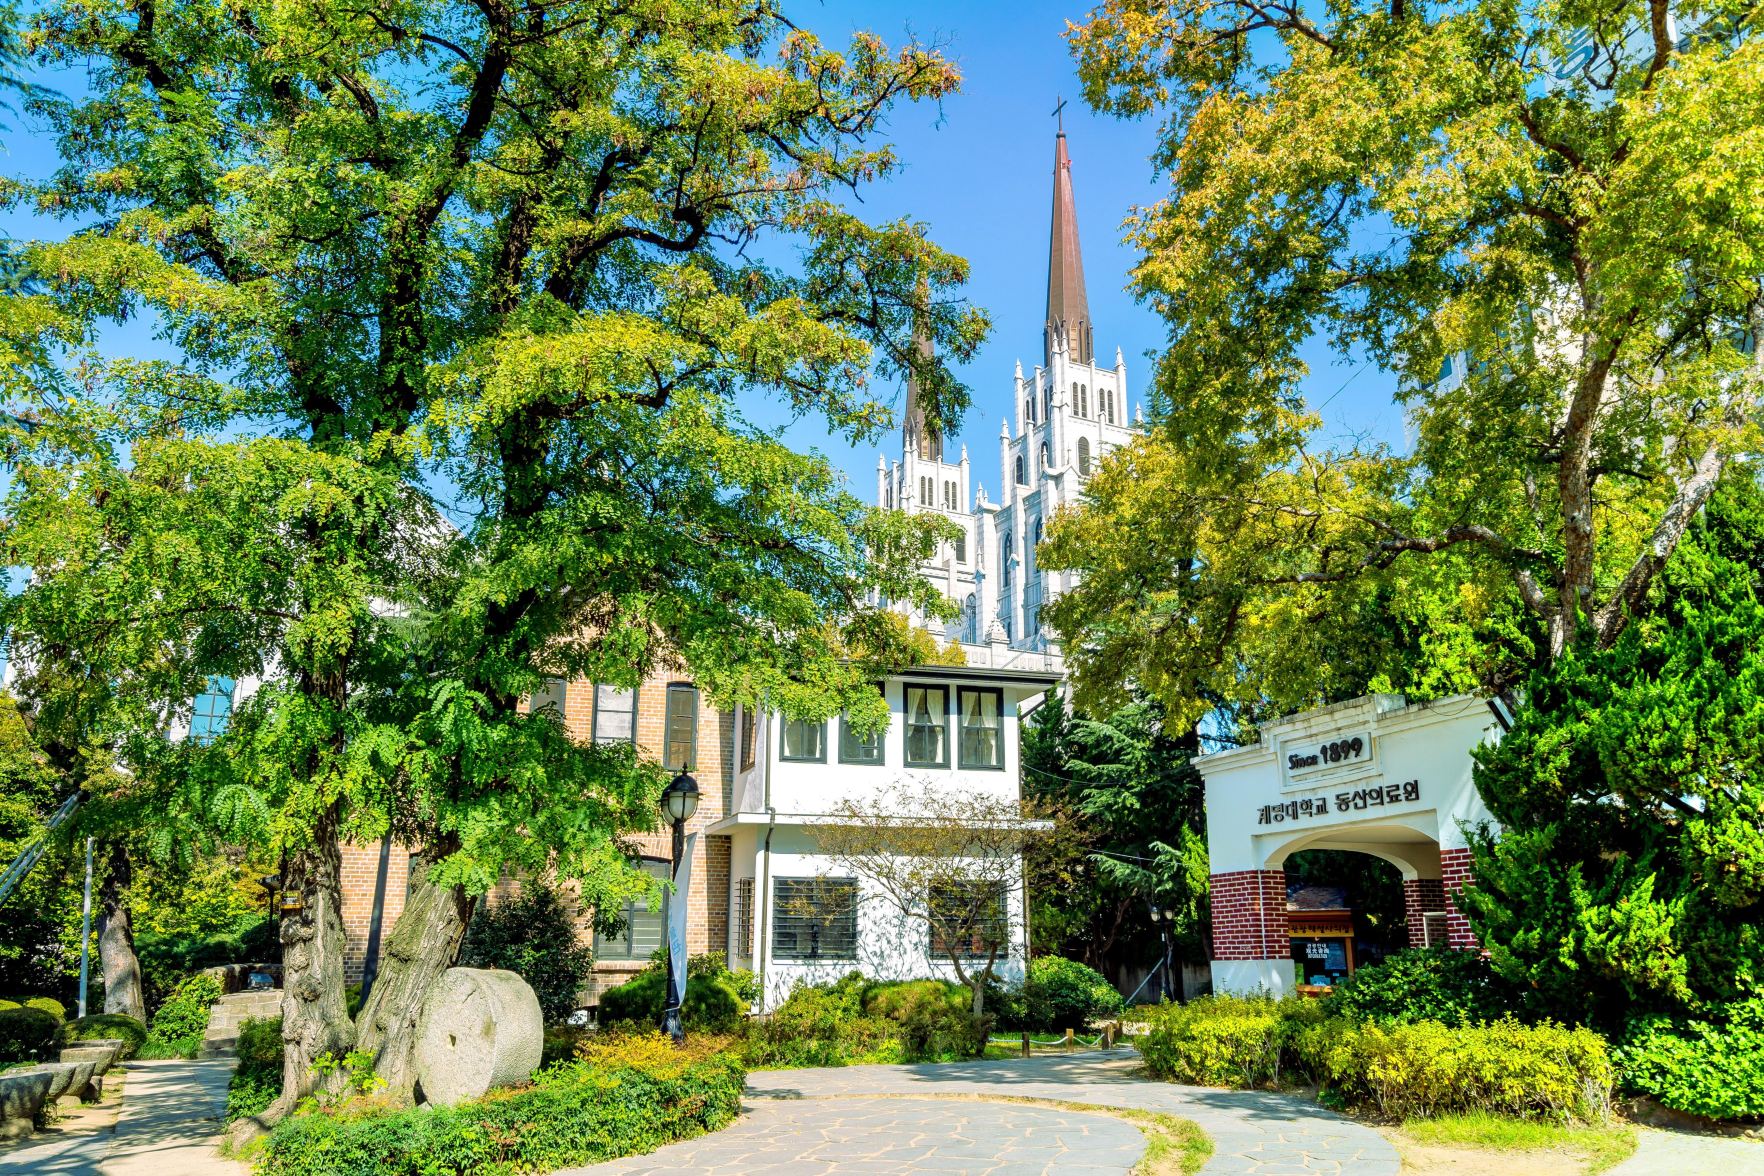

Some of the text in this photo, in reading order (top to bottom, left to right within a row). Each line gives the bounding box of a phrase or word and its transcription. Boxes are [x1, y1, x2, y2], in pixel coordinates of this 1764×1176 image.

[1288, 737, 1363, 770] Since 1899
[1257, 779, 1420, 825] 계명대학교 동산의료원
